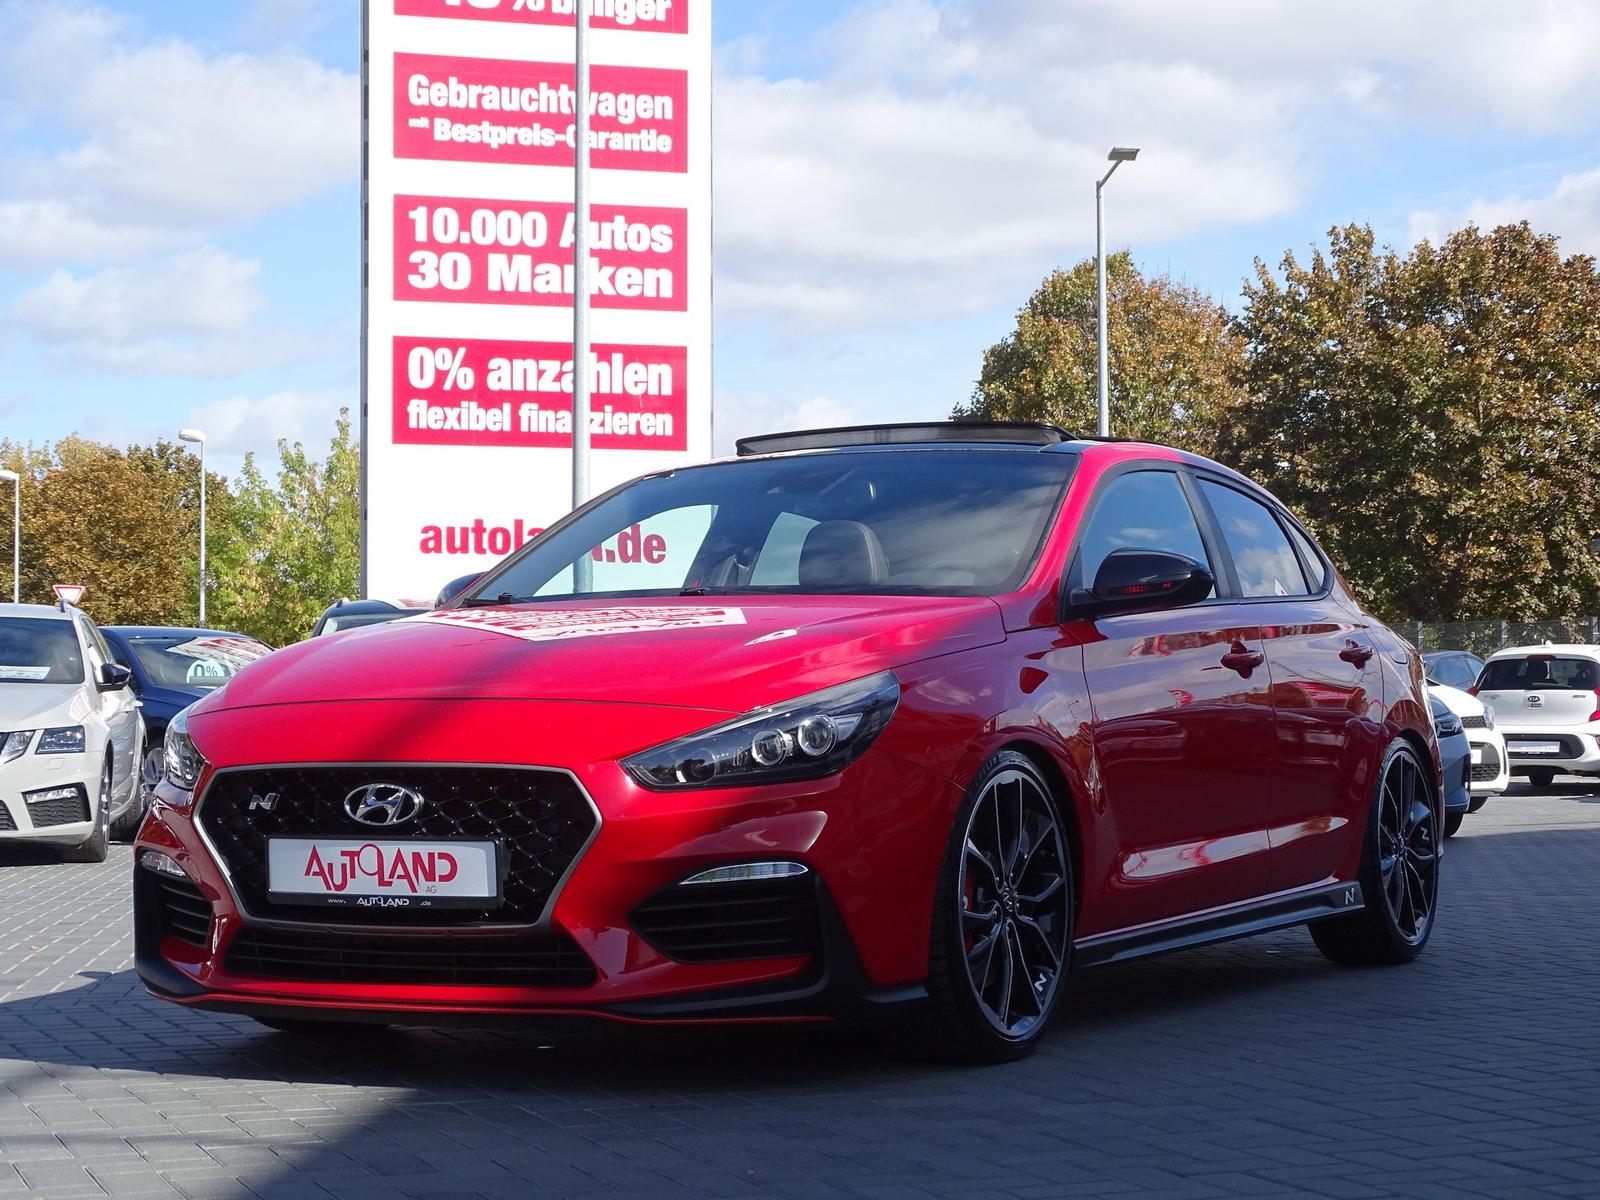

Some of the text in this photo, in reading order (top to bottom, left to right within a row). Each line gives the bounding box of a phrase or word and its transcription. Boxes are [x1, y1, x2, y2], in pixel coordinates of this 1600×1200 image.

[551, 0, 673, 25] bliger
[408, 116, 430, 129] mit
[408, 206, 673, 253] 10.000 Autos
[408, 251, 471, 290] 30
[407, 346, 673, 396] 0% anzahlen
[407, 399, 673, 437] flexibel finazieren
[419, 518, 667, 565] autol.de
[425, 885, 437, 894] AG
